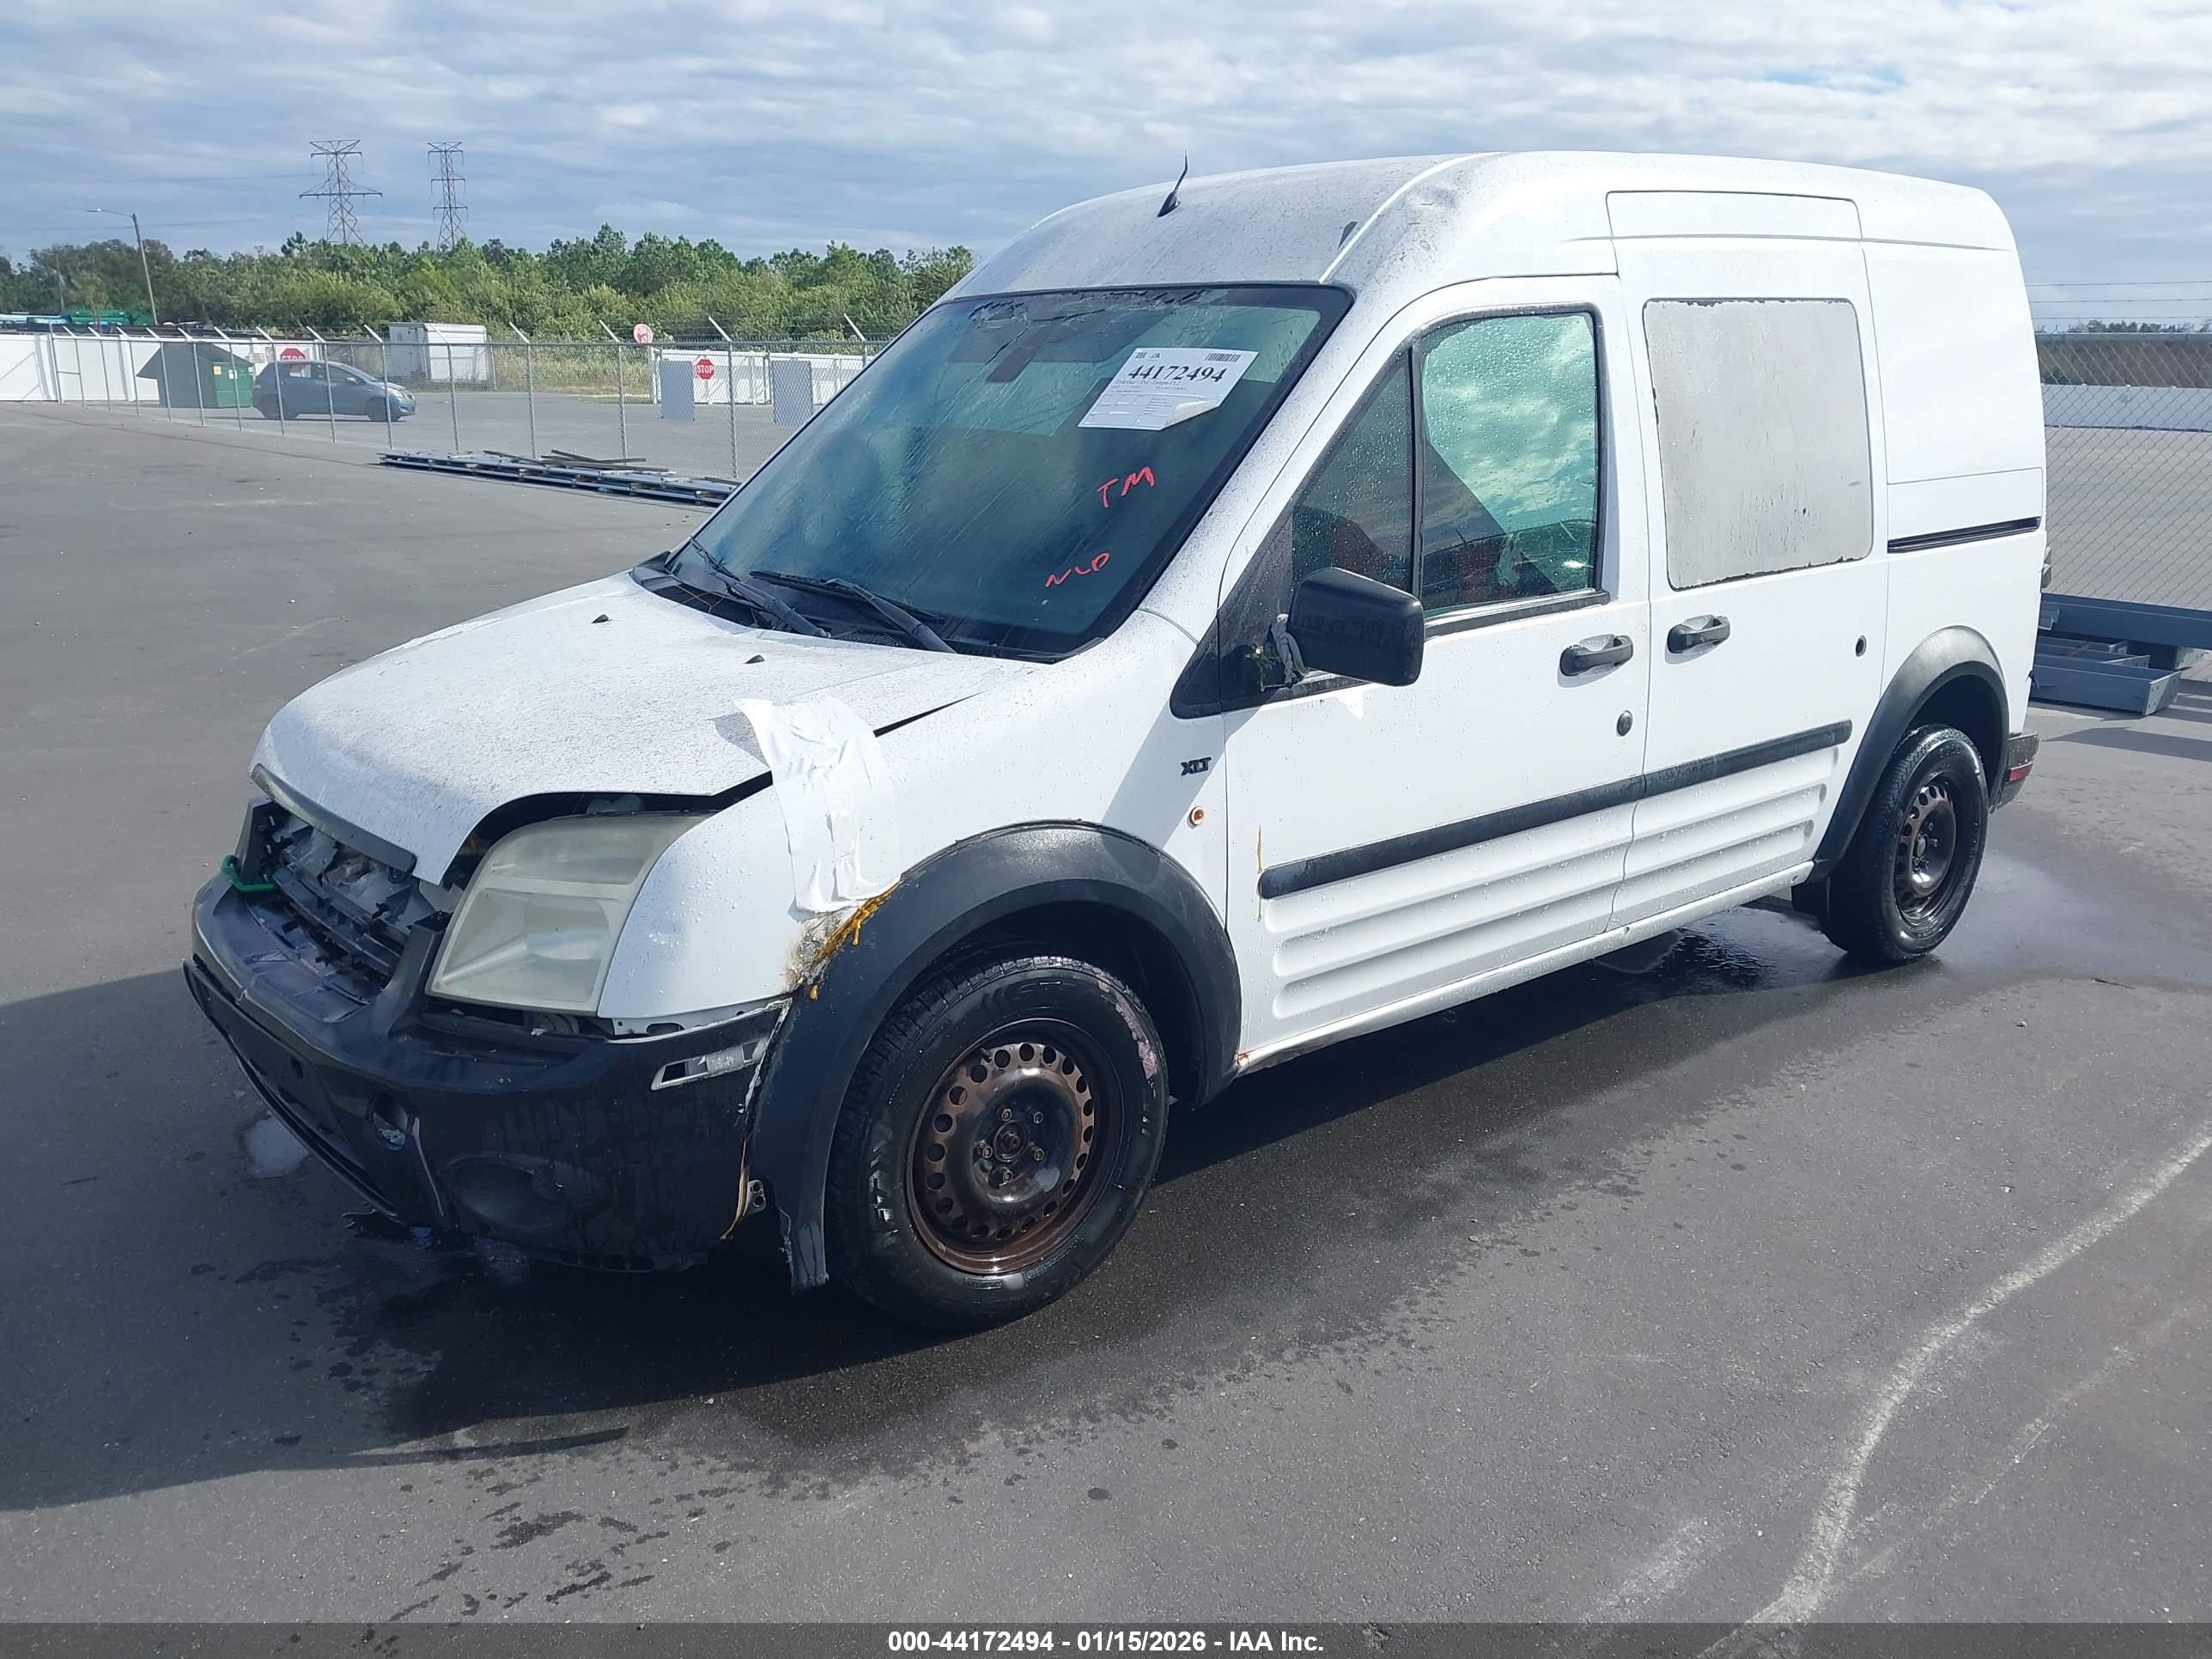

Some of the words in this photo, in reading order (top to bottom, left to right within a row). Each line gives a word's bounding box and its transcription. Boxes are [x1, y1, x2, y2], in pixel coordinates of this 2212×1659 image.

[696, 364, 714, 374] STOP
[1128, 365, 1228, 382] 44172494
[1097, 466, 1155, 508] TM
[1181, 757, 1212, 776] XLT
